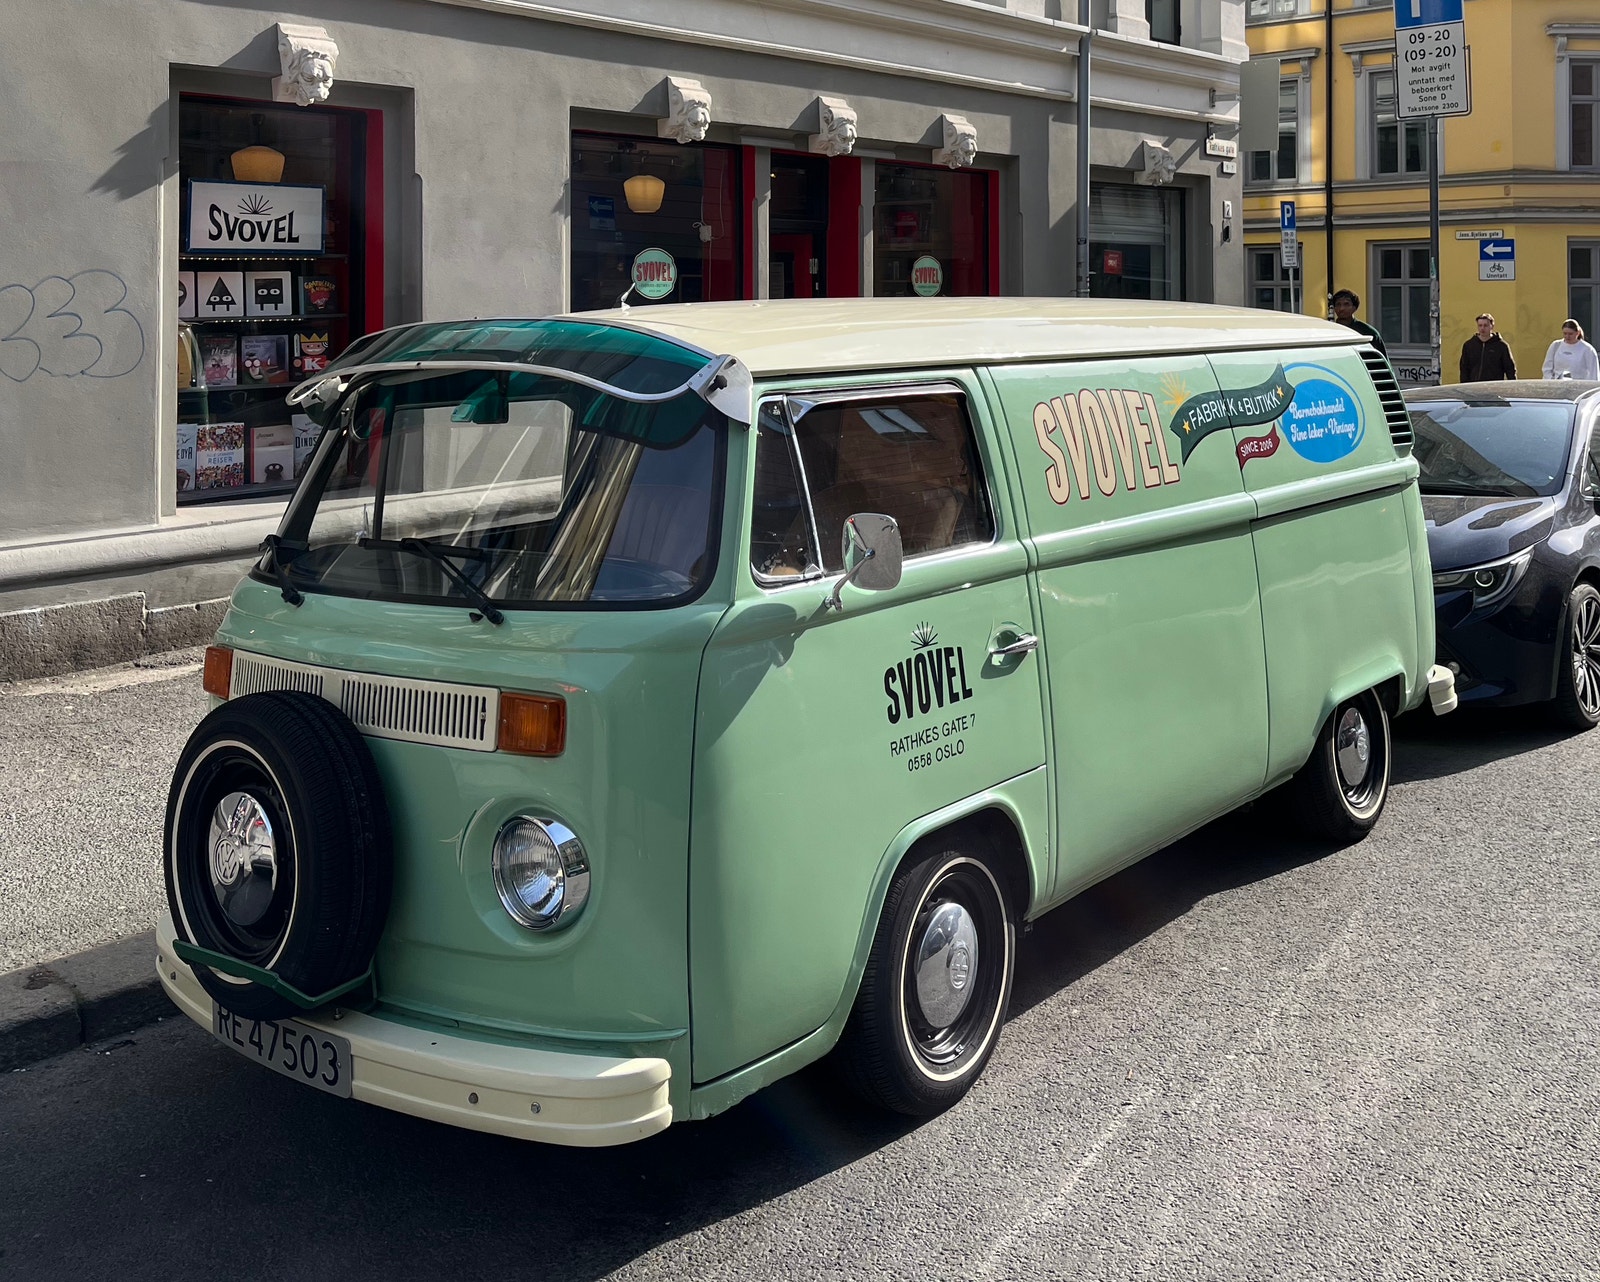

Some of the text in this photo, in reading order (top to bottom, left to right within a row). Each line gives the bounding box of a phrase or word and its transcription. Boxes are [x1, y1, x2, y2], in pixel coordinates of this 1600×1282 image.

[1429, 63, 1451, 72] avgift
[1408, 74, 1455, 86] unntatt med
[1411, 84, 1453, 94] beboerkort
[1418, 94, 1437, 102] Sone
[1442, 102, 1459, 110] 2300
[208, 203, 299, 243] SVOVEL
[1283, 204, 1292, 226] P
[636, 260, 673, 282] SVOVEL
[914, 266, 940, 284] SVOVEL
[303, 357, 322, 371] K
[1188, 388, 1281, 431] FABRIKK & BUTIKK
[1288, 396, 1346, 420] Barnebokhandel
[1290, 417, 1356, 443] Fine leker Vintage
[1032, 388, 1181, 506] SVOVEL
[1240, 437, 1274, 457] SINCE 2006
[207, 456, 233, 464] REISER
[884, 646, 973, 725] SVOVEL
[890, 713, 976, 758] RATHKES GATE 7
[908, 739, 965, 772] 0558 OSLO
